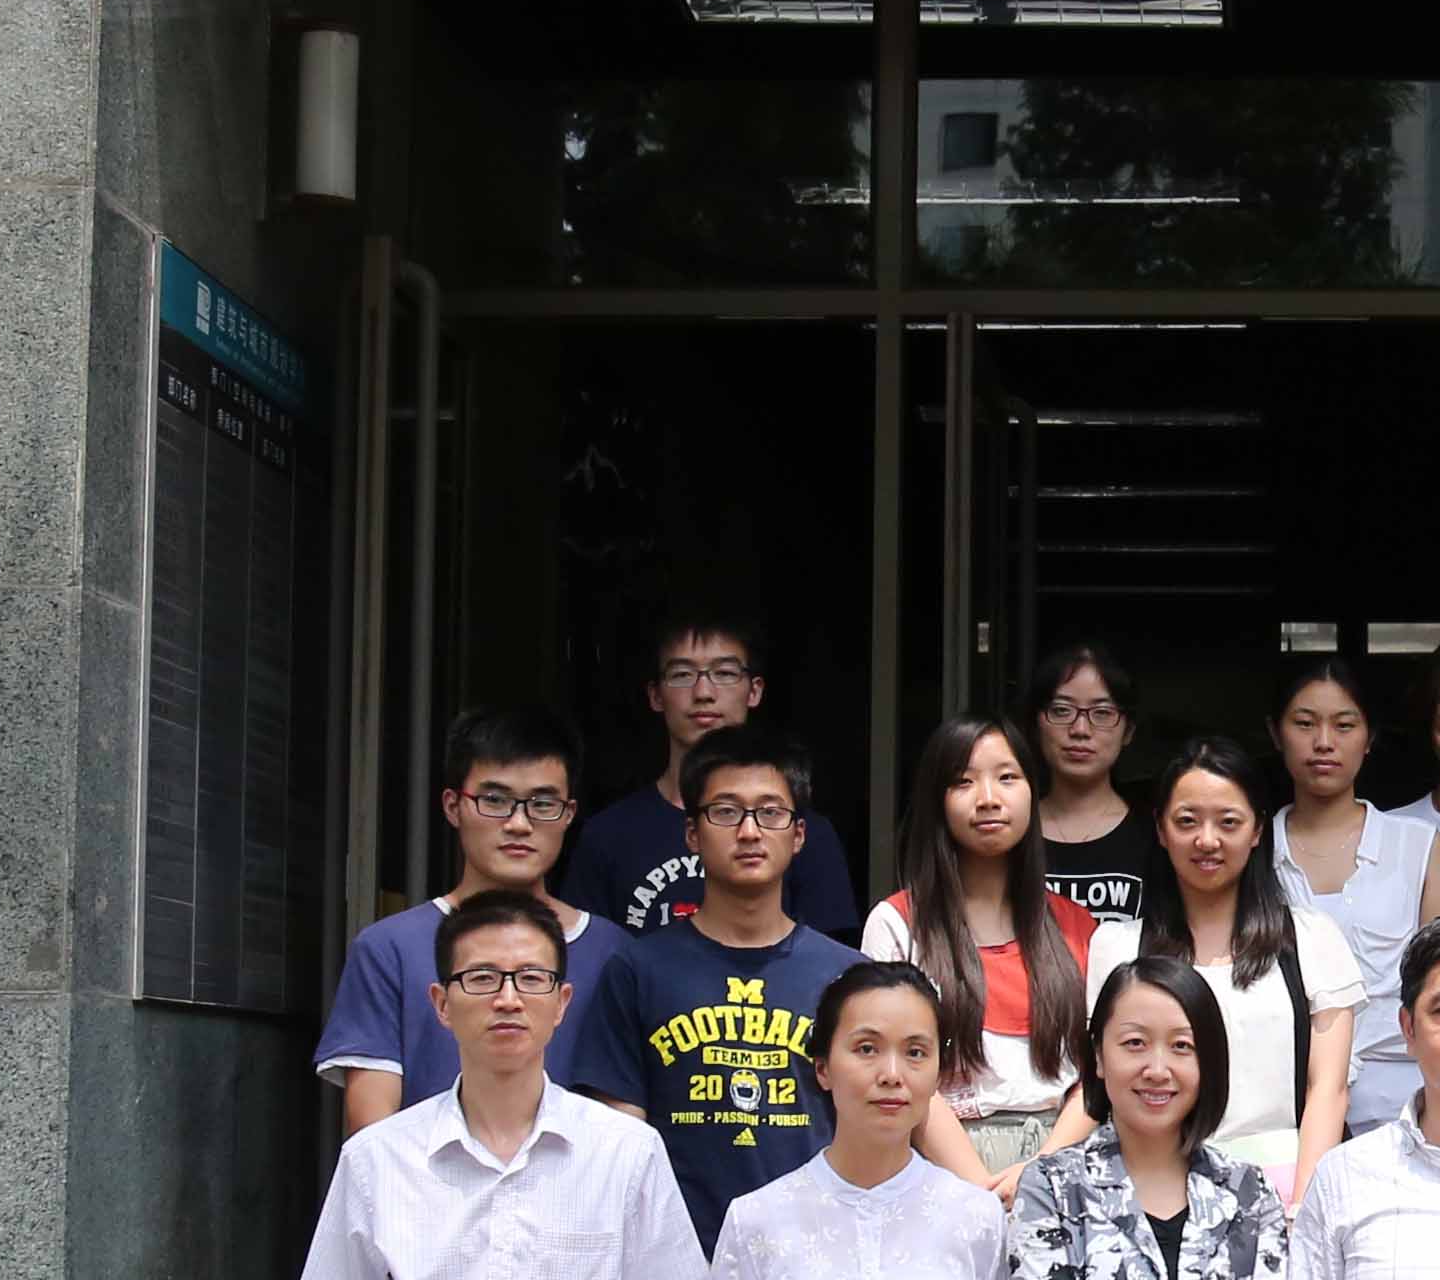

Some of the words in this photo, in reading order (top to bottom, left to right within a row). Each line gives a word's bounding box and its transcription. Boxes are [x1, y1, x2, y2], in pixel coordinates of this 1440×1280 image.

[726, 976, 765, 1005] M
[648, 1004, 815, 1067] FOOTBAL
[710, 1048, 753, 1066] TEAM
[757, 1051, 782, 1067] 133
[689, 1074, 723, 1101] 20
[767, 1077, 797, 1105] 12
[671, 1111, 705, 1125] PRIDE
